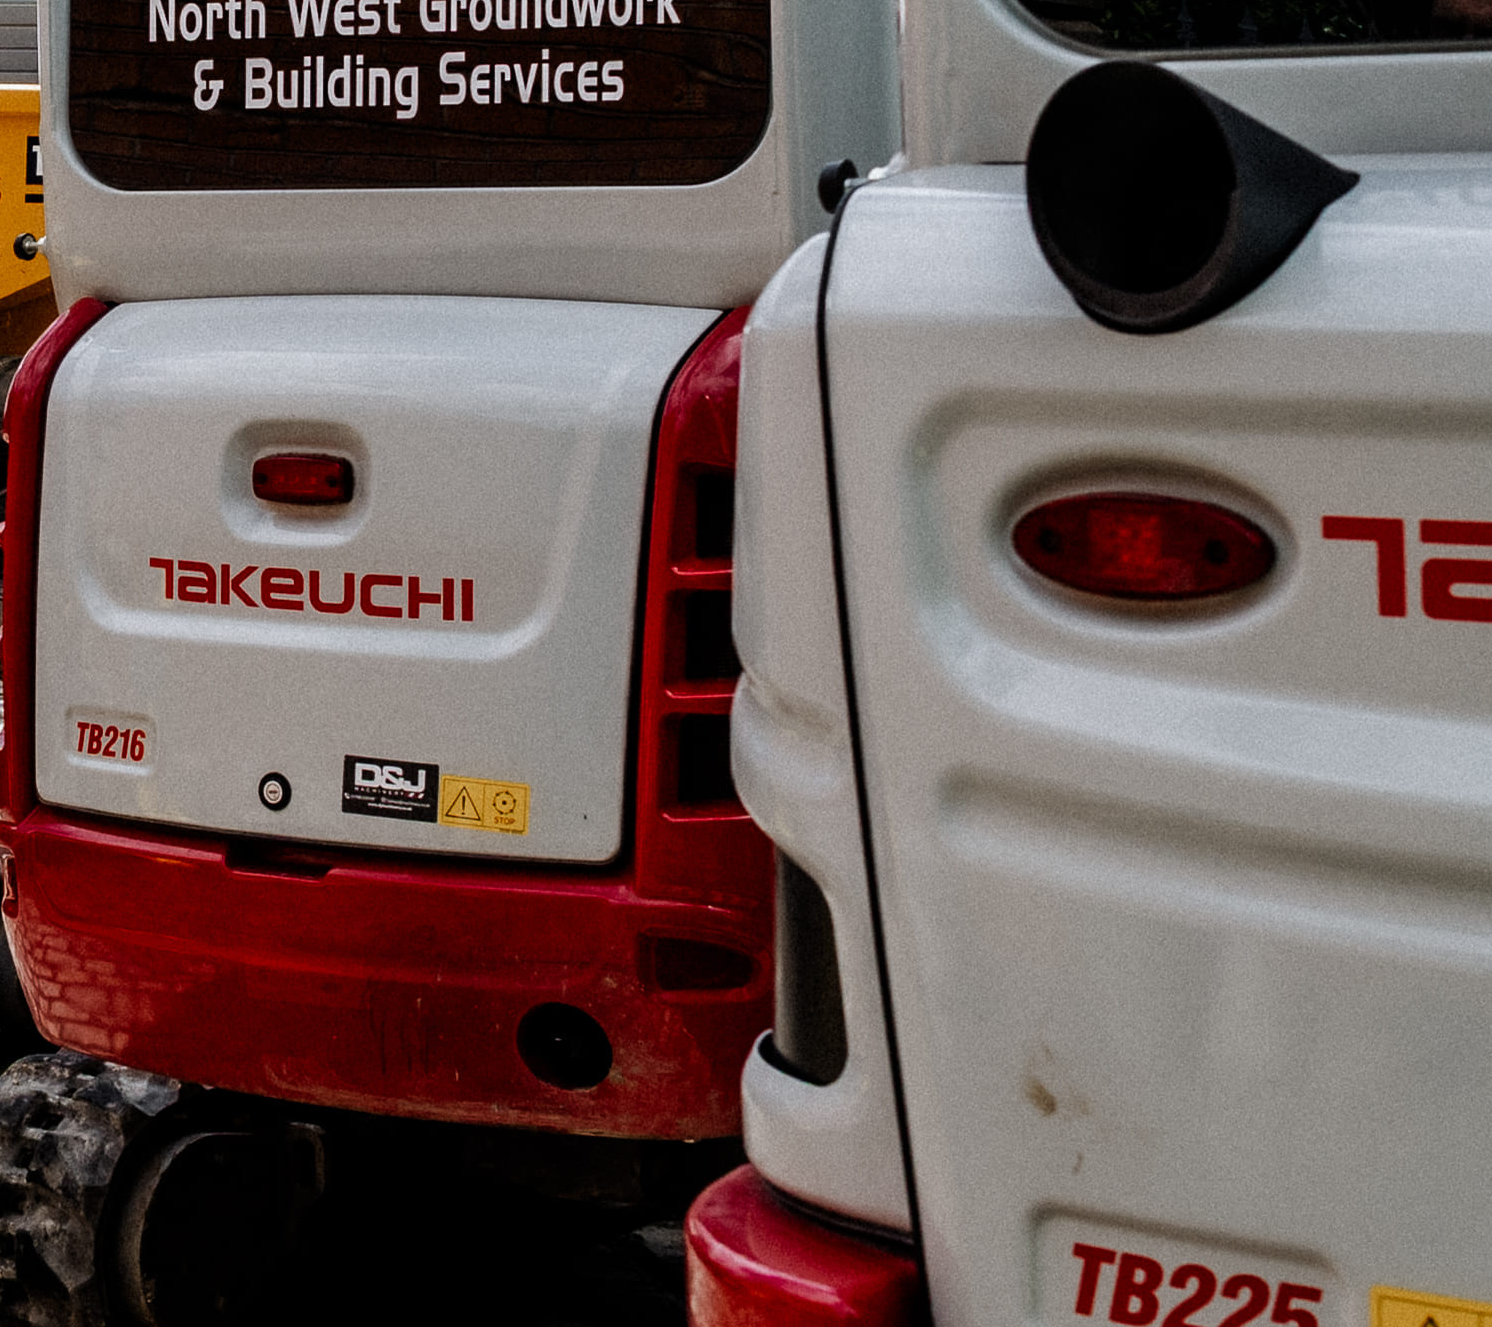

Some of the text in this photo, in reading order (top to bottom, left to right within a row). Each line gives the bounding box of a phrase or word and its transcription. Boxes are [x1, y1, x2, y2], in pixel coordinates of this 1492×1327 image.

[193, 49, 624, 119] & Building Services
[77, 721, 145, 761] TB216
[354, 762, 426, 792] D&J
[494, 815, 516, 825] STOP
